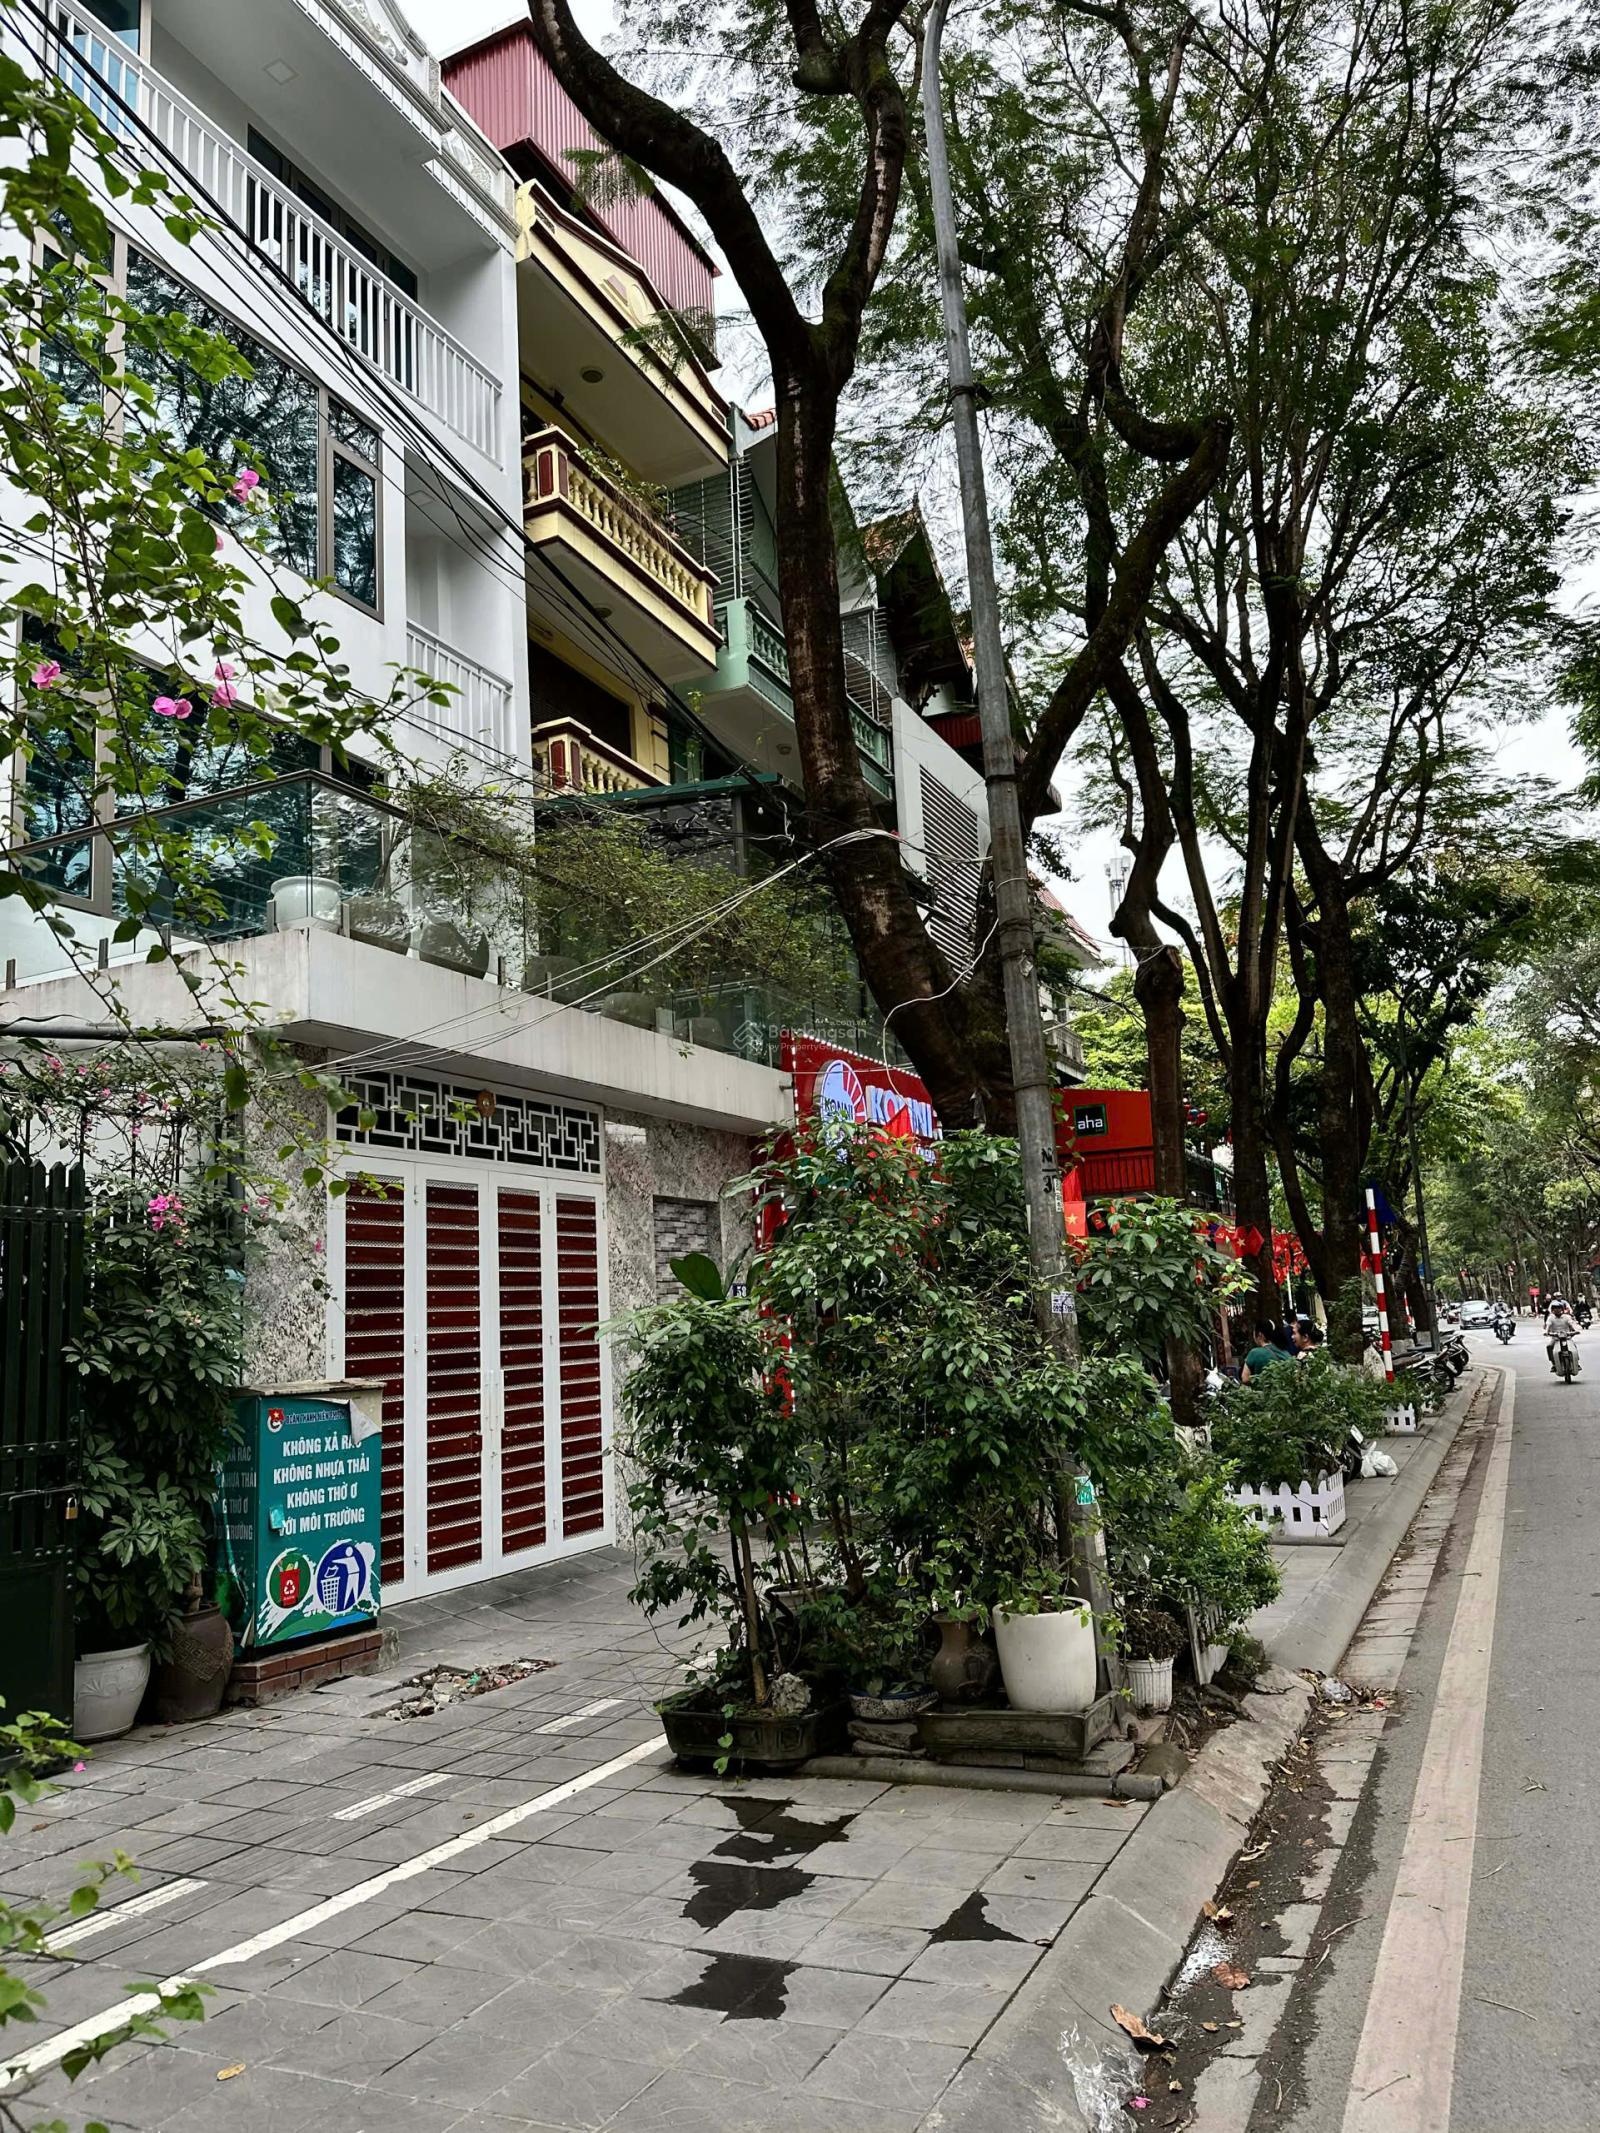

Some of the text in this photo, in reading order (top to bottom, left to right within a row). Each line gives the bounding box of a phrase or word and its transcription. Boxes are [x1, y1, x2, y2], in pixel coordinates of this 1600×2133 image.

[1077, 1114, 1103, 1130] aha
[283, 1436, 321, 1457] KHÔNG
[324, 1431, 339, 1452] XẢ
[273, 1452, 370, 1485] KHÔNG NHỰA THẢI
[287, 1481, 358, 1509] KHÔNG THỜ Ơ
[299, 1511, 321, 1533] MÔI
[323, 1506, 365, 1529] TRƯỜNG
